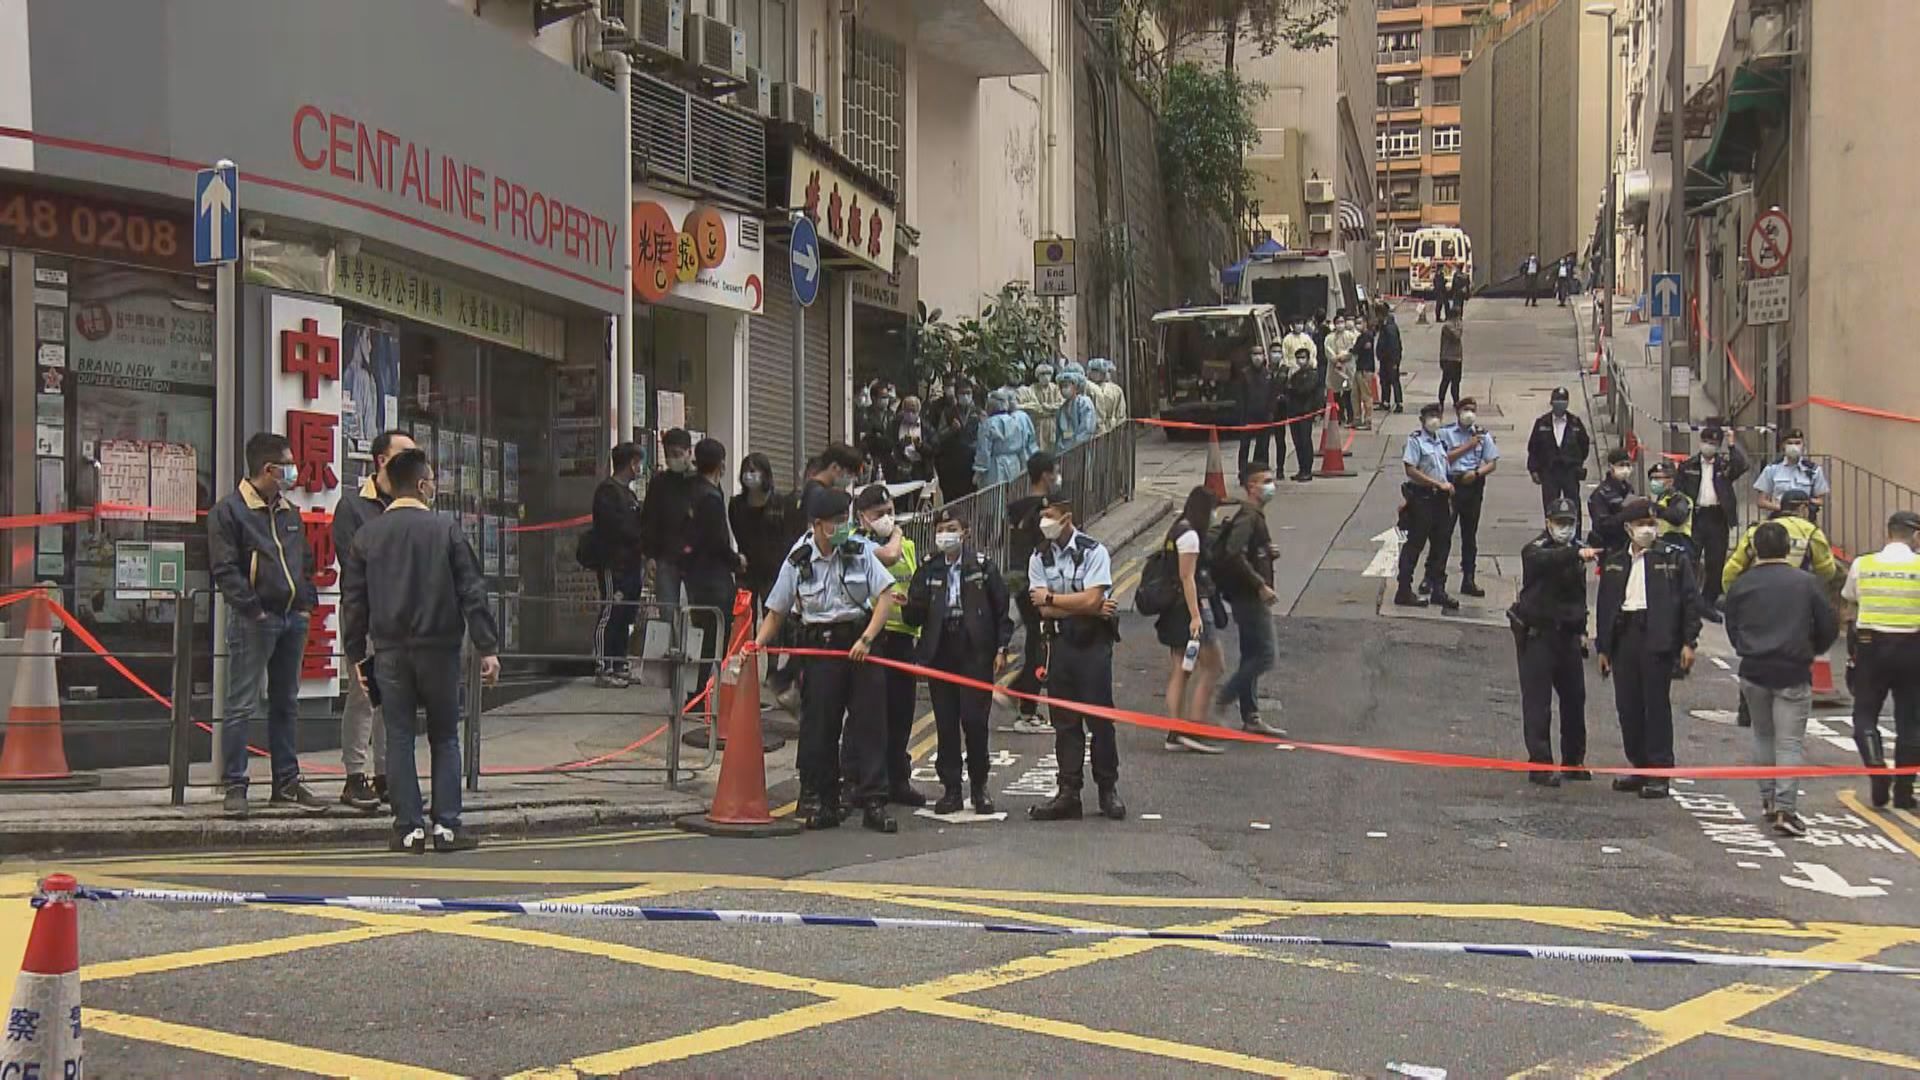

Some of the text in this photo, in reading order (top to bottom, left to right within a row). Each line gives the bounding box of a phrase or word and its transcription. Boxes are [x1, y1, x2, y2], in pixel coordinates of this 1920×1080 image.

[292, 105, 617, 272] CENTALINE PROPERTY
[72, 206, 177, 256] 0208
[1047, 268, 1065, 278] End
[78, 357, 122, 374] BRAND
[126, 363, 155, 378] NEW
[113, 376, 171, 393] COLLECTION
